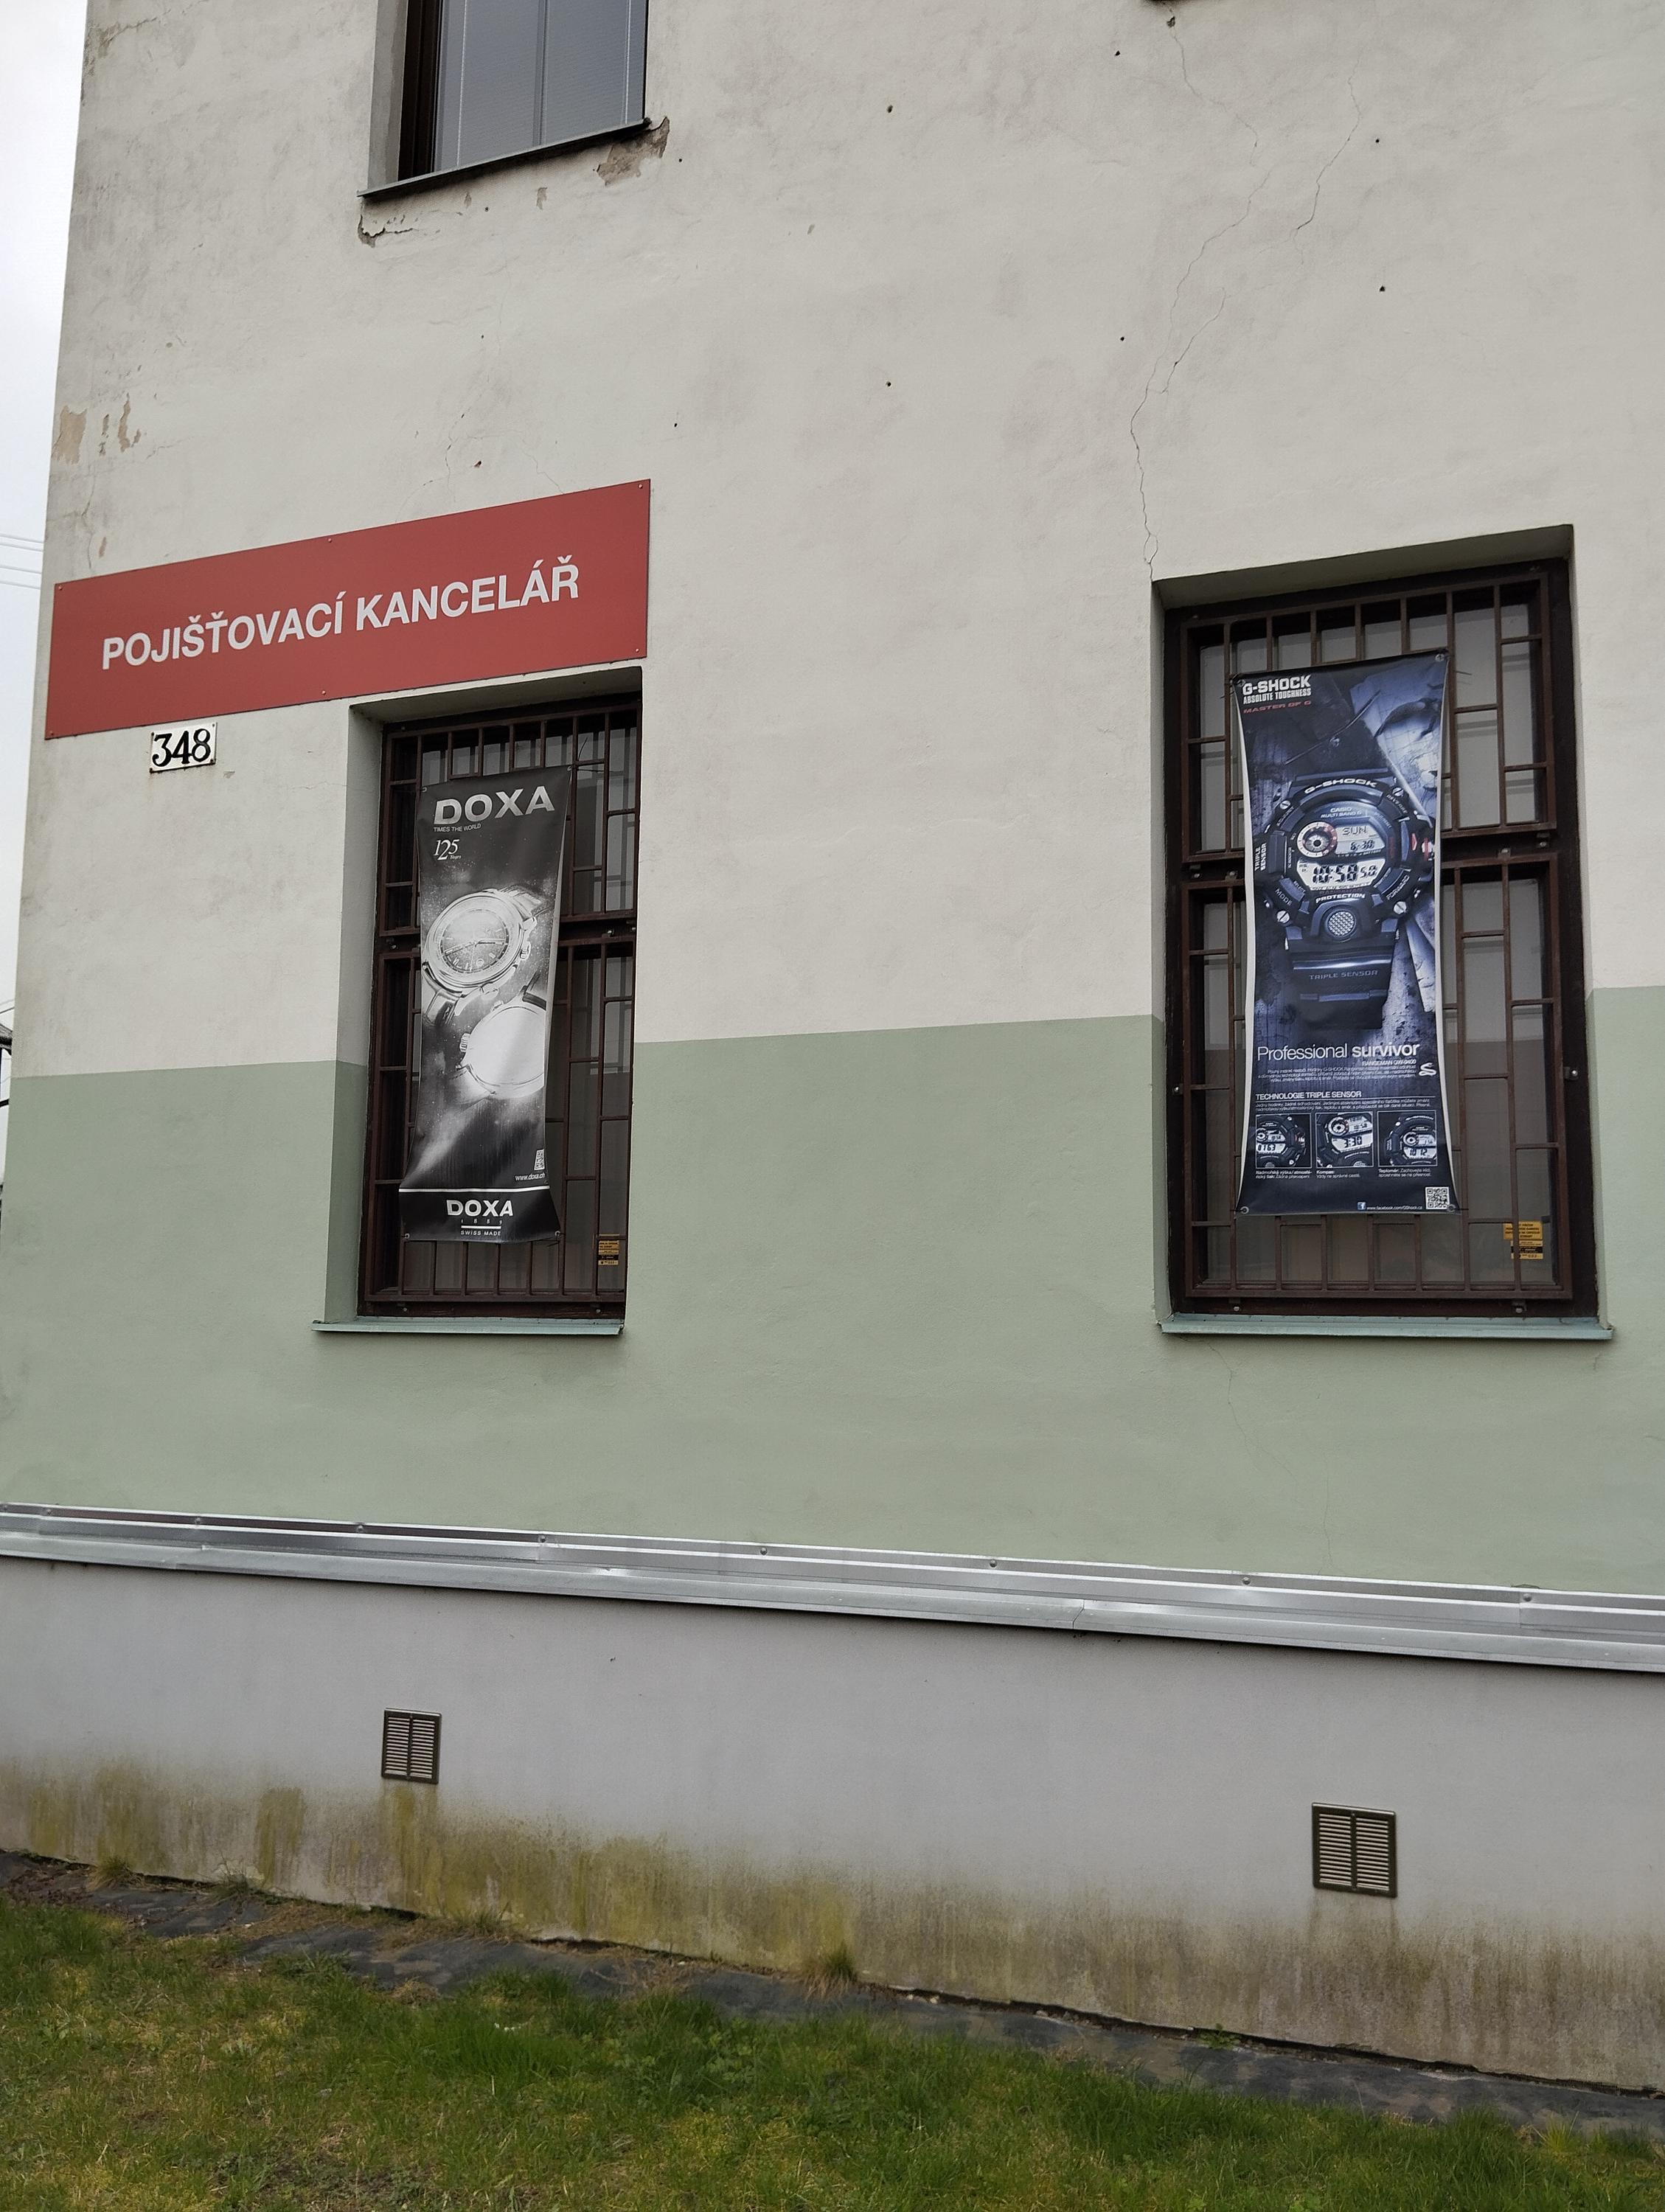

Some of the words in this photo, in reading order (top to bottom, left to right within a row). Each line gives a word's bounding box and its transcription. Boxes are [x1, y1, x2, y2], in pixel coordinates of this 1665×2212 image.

[102, 591, 347, 670] POJIŠŤOVACÍ
[356, 554, 579, 631] KANCELÁŘ
[1242, 674, 1311, 695] G-SHOCK
[1243, 692, 1273, 704] ABSOLUTE
[1275, 687, 1311, 700] TOUGHNESS
[1243, 703, 1285, 714] MASTER
[152, 728, 211, 768] 348
[1304, 778, 1377, 794] G-SHOCK
[434, 785, 555, 825] DOXA
[463, 824, 482, 832] WORLD
[1342, 826, 1366, 835] SUN
[434, 839, 460, 860] 125
[1275, 888, 1293, 906] MODE
[1315, 893, 1366, 904] PROTECTION
[1257, 1043, 1347, 1061] Professional
[1352, 1041, 1420, 1057] survivor
[1256, 1091, 1304, 1100] TECHNOLOGIE
[1332, 1091, 1362, 1099] SENSOR
[515, 1172, 546, 1180] www.doxa.ch
[446, 1200, 514, 1217] DOXA
